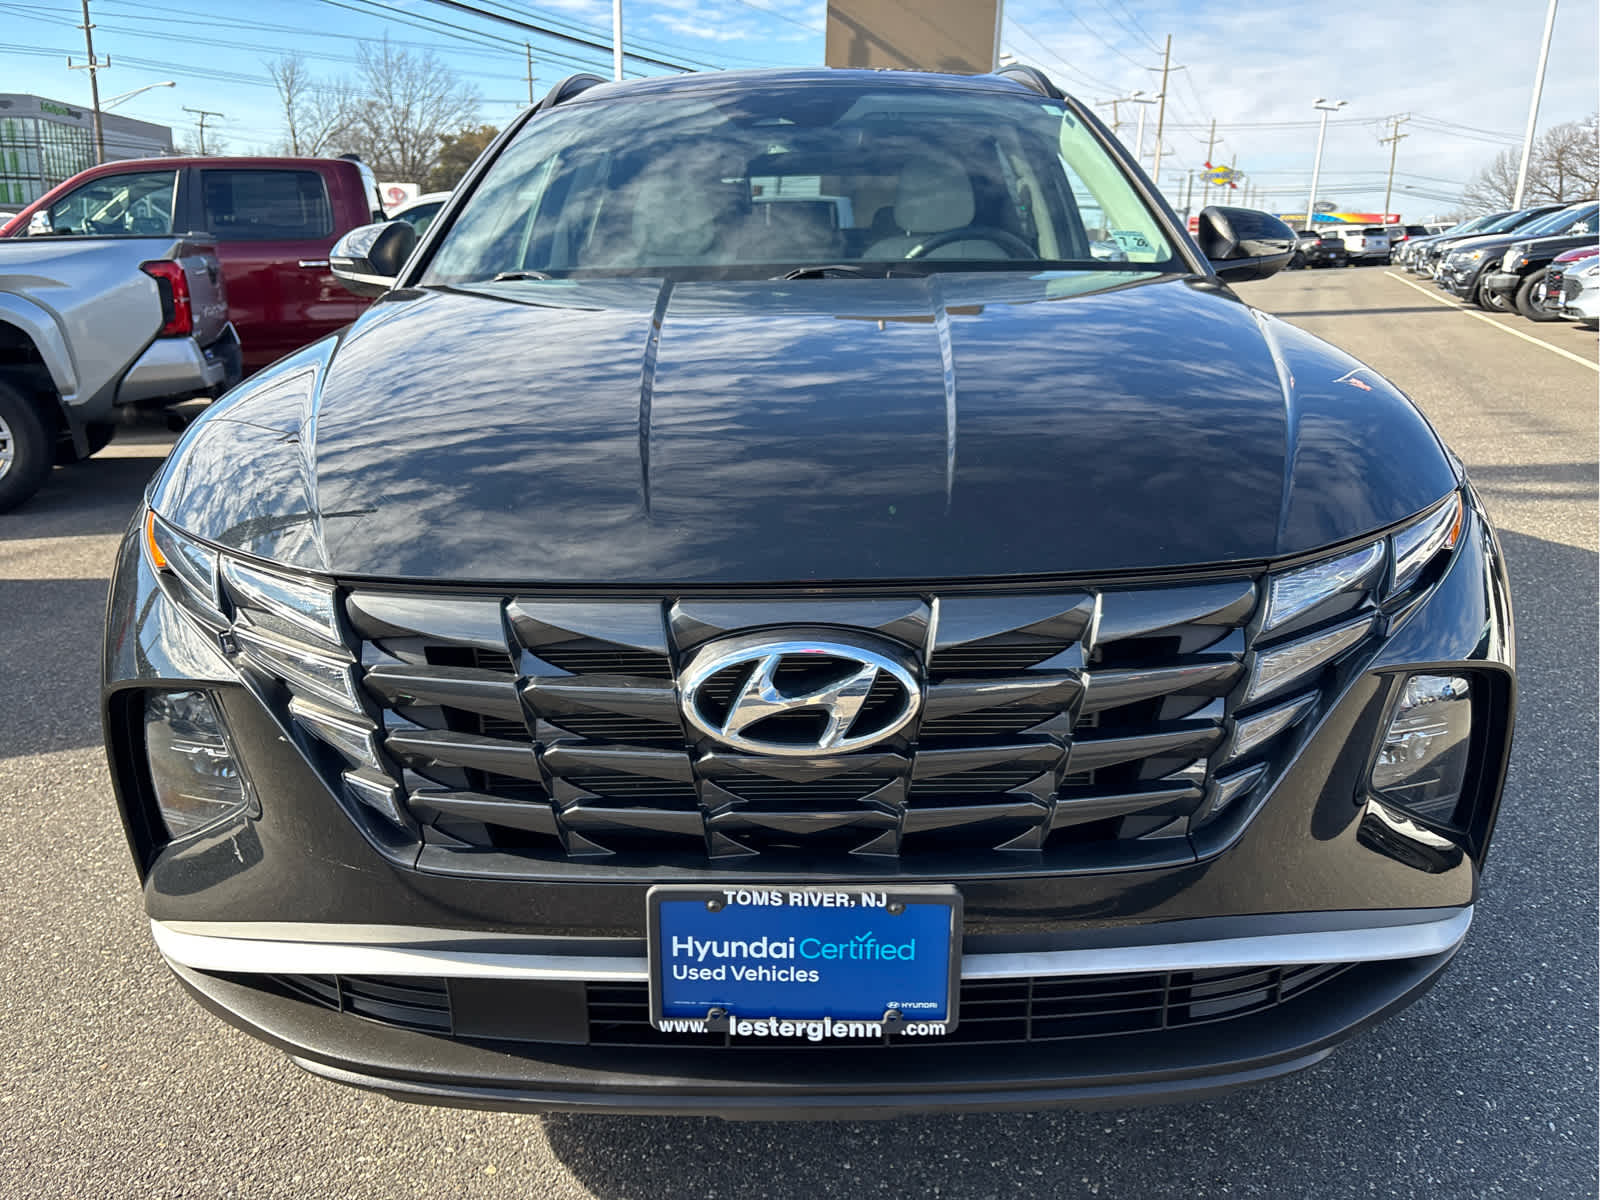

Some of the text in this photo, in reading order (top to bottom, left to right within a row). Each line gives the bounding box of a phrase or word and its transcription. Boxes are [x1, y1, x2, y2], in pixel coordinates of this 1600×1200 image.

[723, 888, 888, 908] TOMS RIVER, NJ
[672, 931, 916, 962] Hyundai Certified
[672, 964, 821, 983] Used Vehicles
[658, 1019, 709, 1034] www.
[729, 1015, 883, 1042] lesterglenn
